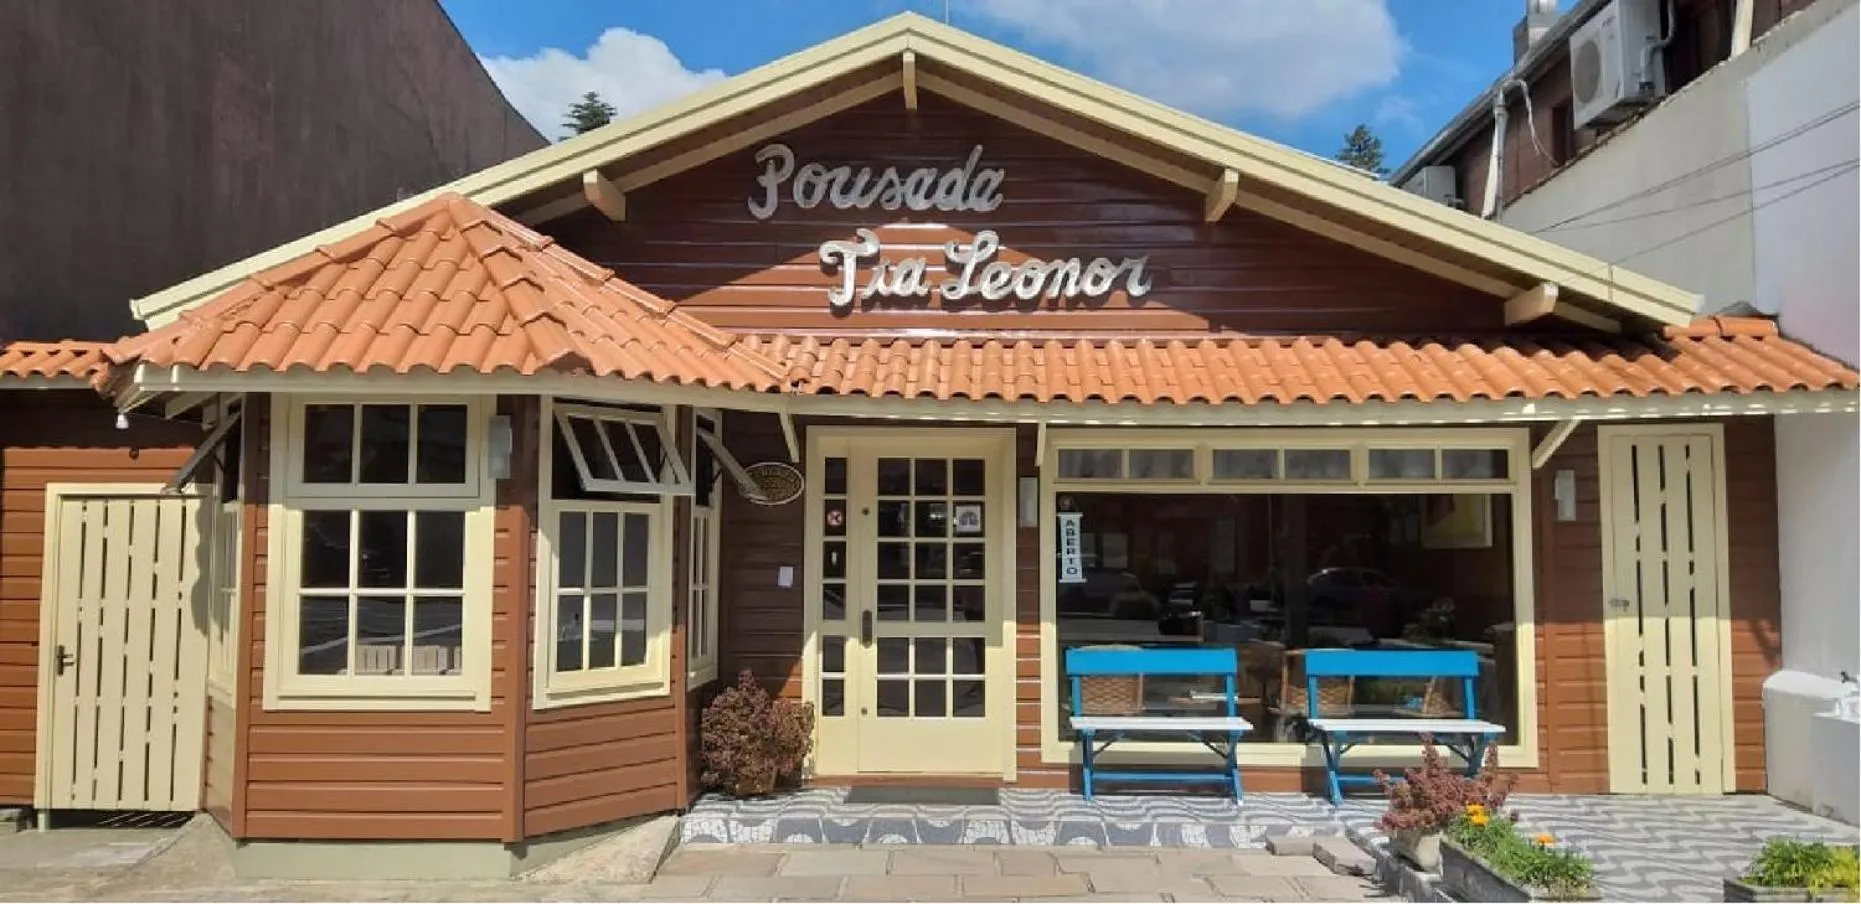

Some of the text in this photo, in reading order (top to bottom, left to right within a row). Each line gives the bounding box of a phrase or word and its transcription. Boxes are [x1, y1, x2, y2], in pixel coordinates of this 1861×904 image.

[748, 143, 1004, 219] Pousada
[819, 228, 1152, 305] Tia Leonor
[1065, 519, 1078, 575] ABERTO
